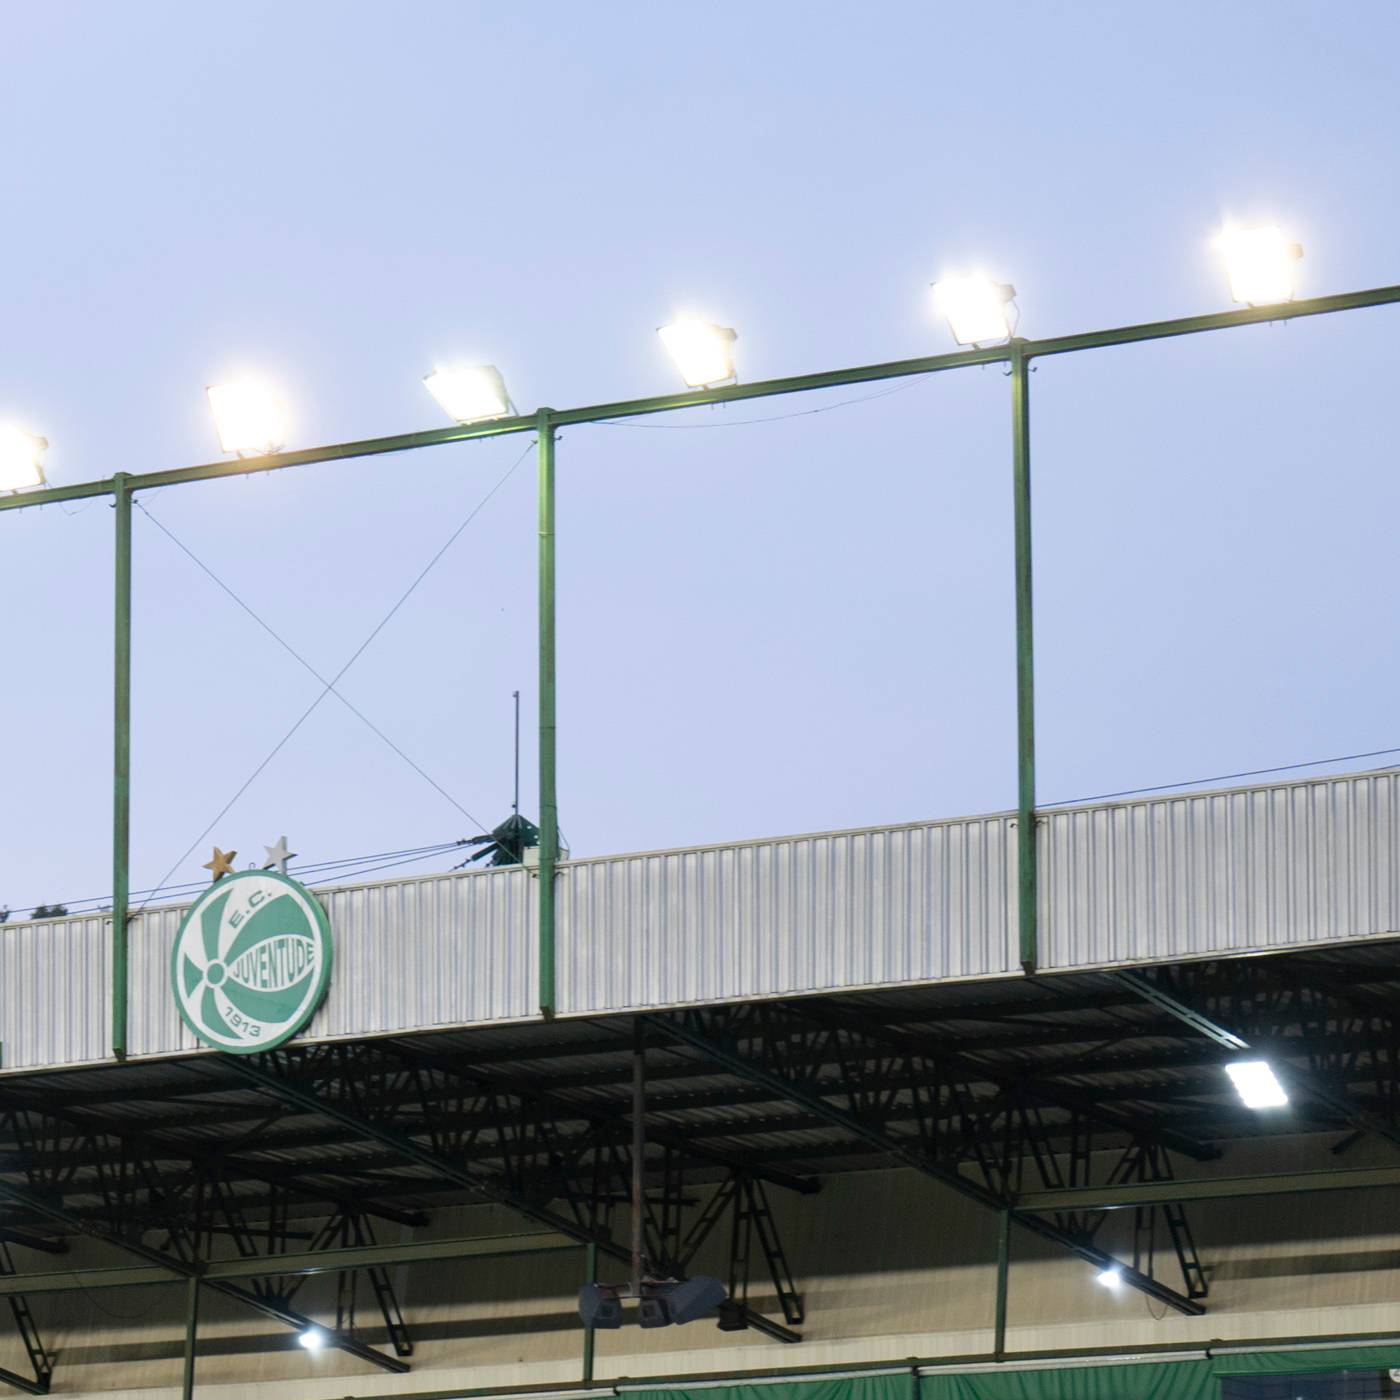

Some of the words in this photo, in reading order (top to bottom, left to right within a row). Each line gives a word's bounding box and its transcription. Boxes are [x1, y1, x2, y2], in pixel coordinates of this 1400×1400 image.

[228, 890, 273, 929] E.C.
[233, 937, 315, 989] JUVENTUDE
[224, 1005, 261, 1037] 1913
